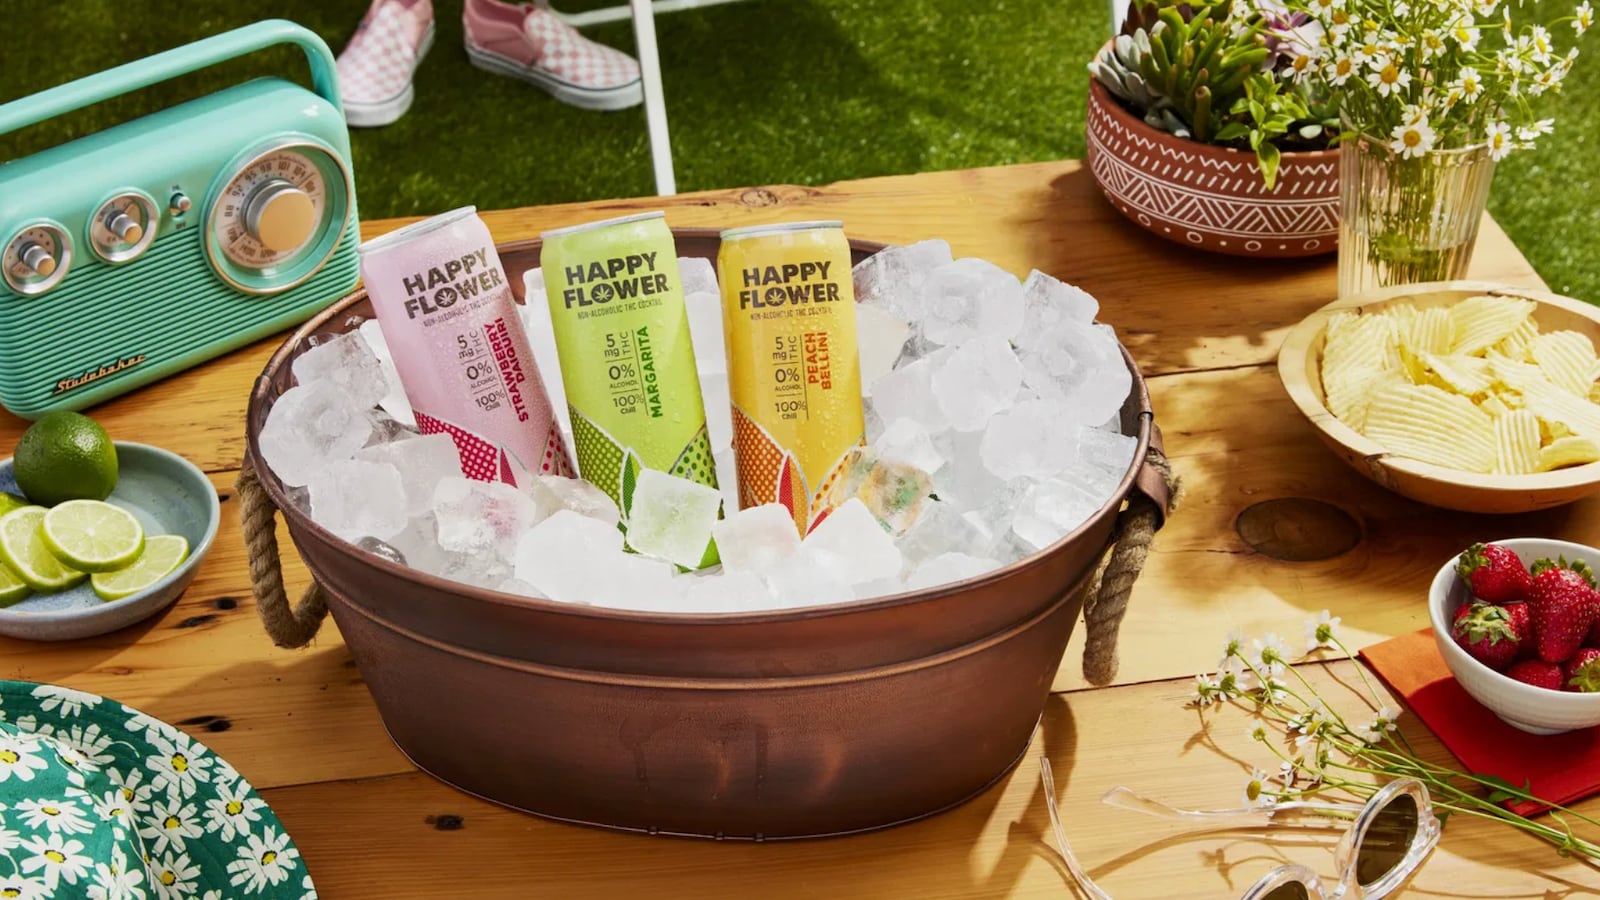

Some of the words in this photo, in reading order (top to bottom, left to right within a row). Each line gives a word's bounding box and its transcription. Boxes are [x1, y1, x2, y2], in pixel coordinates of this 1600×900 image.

[402, 247, 488, 297] HAPPY
[565, 251, 658, 286] HAPPY
[743, 261, 832, 288] HAPPY
[404, 267, 503, 320] FLOWER
[563, 273, 670, 310] FLOWER
[739, 282, 841, 310] FLOWER
[577, 304, 623, 320] NON-ALCOHOLIC
[624, 302, 637, 312] THC
[638, 298, 664, 309] COCKTAIL
[750, 309, 794, 321] NON-ALCOHOLIC
[457, 334, 468, 349] 5
[469, 329, 484, 355] THC
[494, 317, 526, 384] DAIQUIRI
[605, 333, 616, 348] 5
[619, 331, 632, 356] THC
[775, 336, 784, 350] 5
[788, 336, 798, 360] THC
[458, 348, 475, 360] mg
[604, 347, 620, 358] mg
[773, 351, 787, 361] mg
[804, 333, 819, 384] PEACH
[817, 332, 832, 390] BELLINI
[53, 354, 147, 395] Studebaker
[466, 360, 493, 380] 0%
[484, 323, 530, 423] STRAWBERRY
[608, 363, 636, 381] 0%
[637, 326, 663, 418] MARGARITA
[775, 367, 800, 383] 0%
[470, 376, 498, 389] ALCOHOL
[609, 379, 639, 389] ALCOHOL
[774, 383, 803, 392] ALCOHOL
[475, 390, 505, 408] 100%
[613, 394, 645, 408] 100%
[775, 400, 807, 413] 100%
[620, 406, 637, 415] Chill
